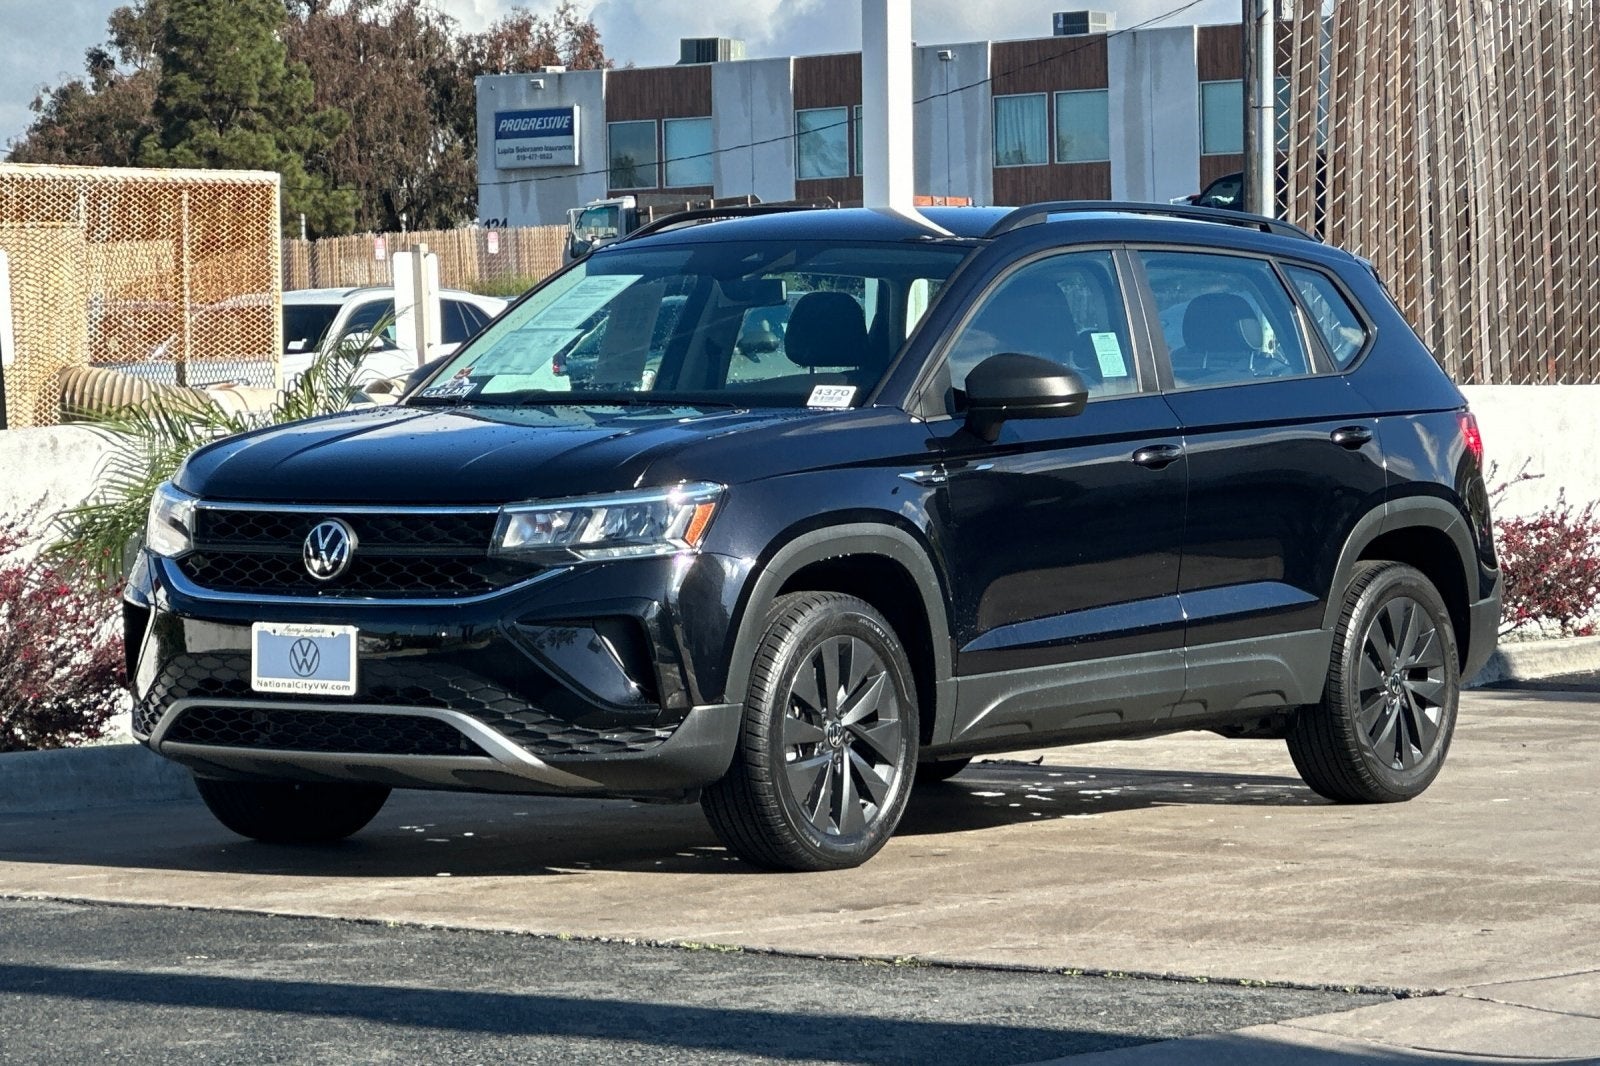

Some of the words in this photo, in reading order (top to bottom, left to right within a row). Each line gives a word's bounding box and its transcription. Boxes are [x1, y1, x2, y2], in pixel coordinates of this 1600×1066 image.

[498, 115, 571, 132] PROGRESSIVE
[815, 388, 850, 397] 4370
[257, 680, 351, 691] NationalCityVW.com
